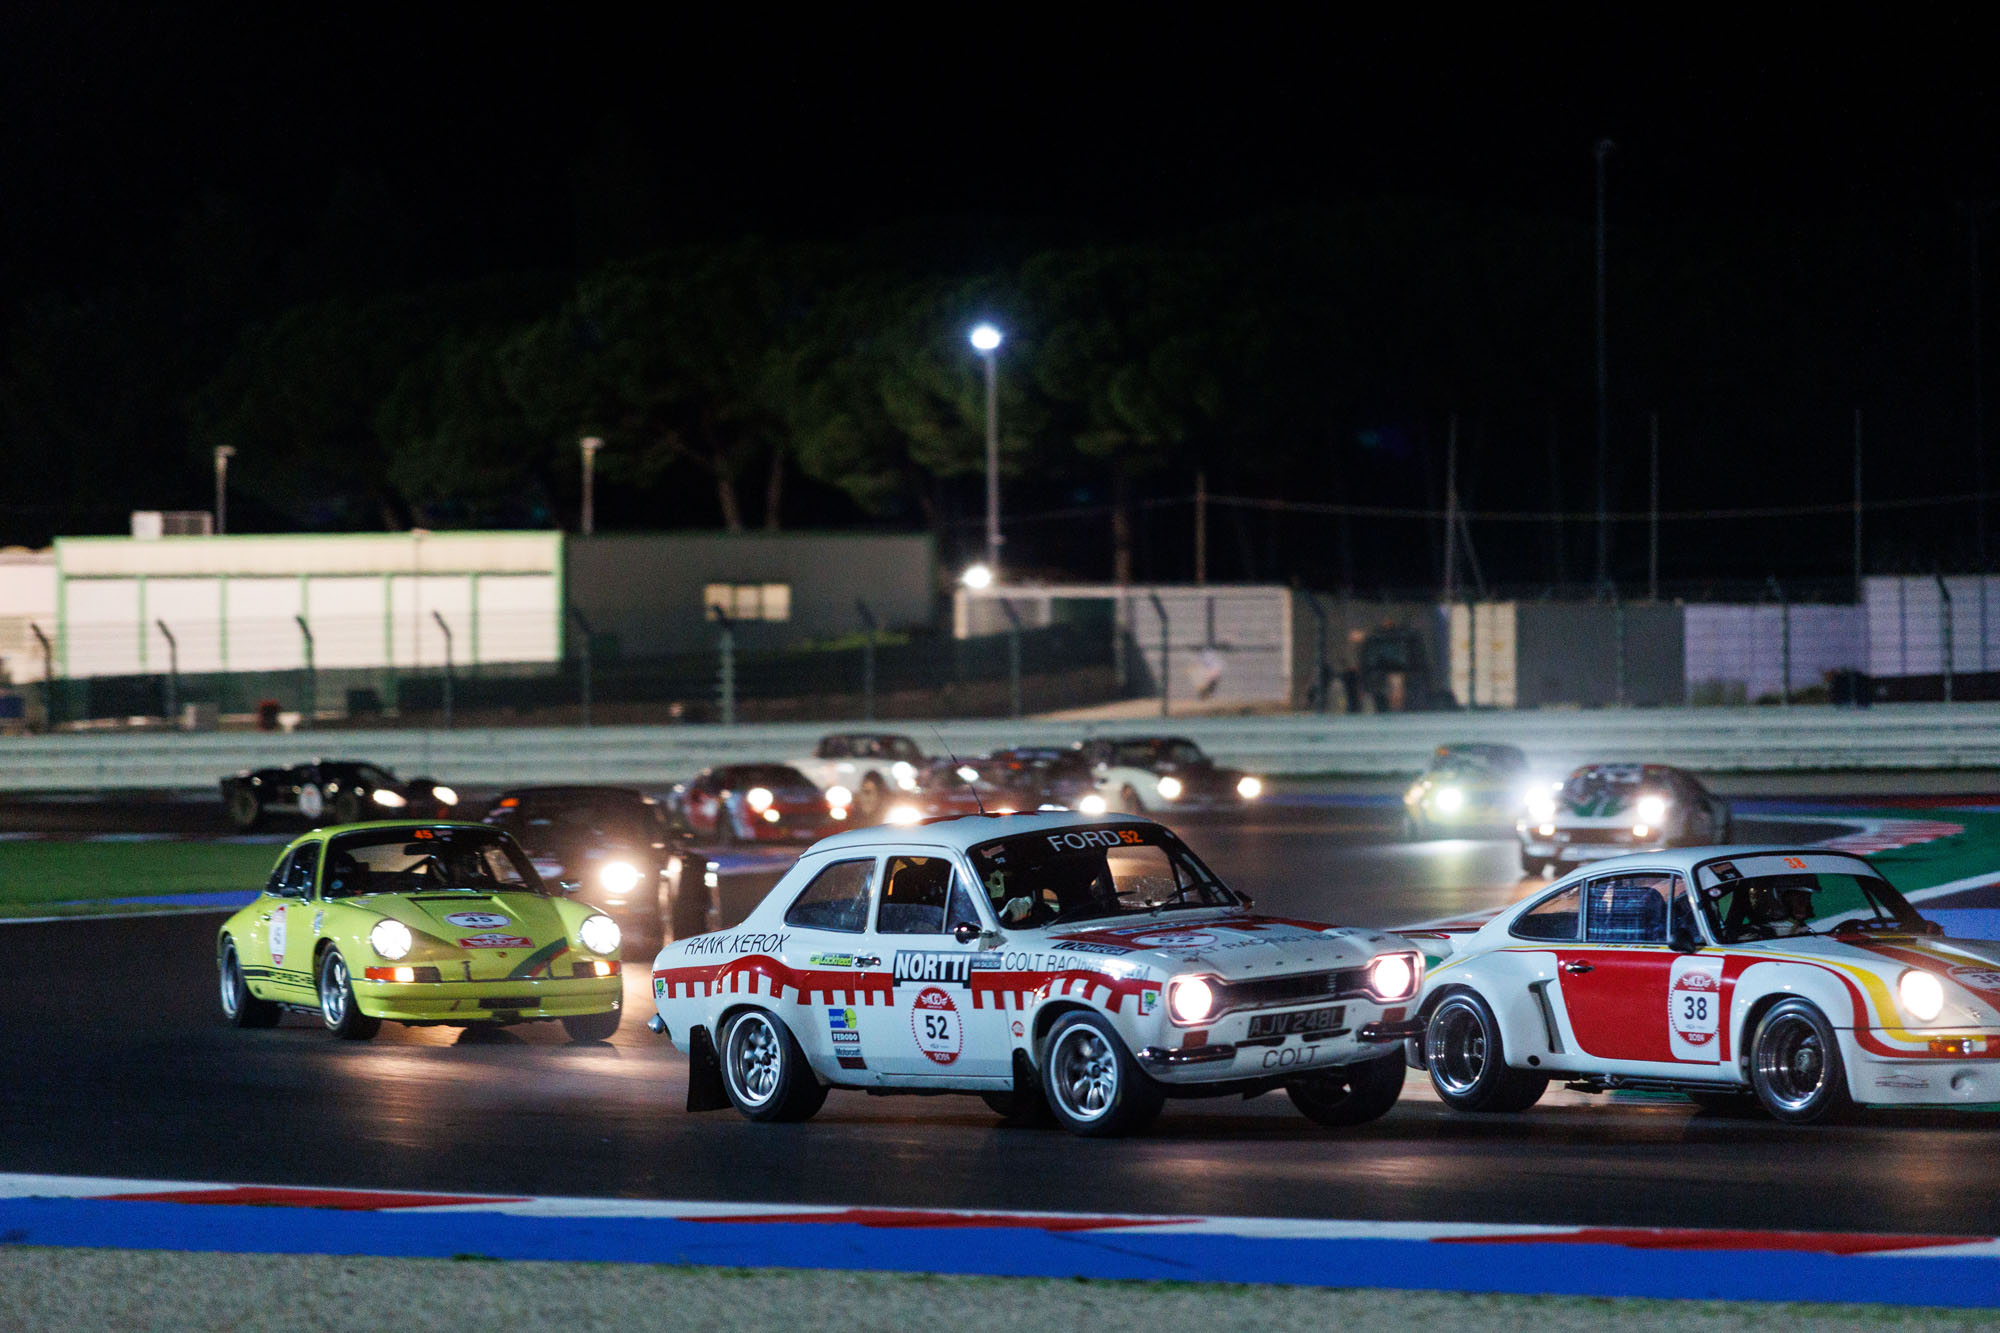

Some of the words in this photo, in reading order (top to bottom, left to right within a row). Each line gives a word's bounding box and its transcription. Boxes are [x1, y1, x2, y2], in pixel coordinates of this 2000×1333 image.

[414, 829, 434, 839] 45
[1046, 830, 1121, 852] FORD
[1118, 830, 1144, 844] 52
[1783, 857, 1807, 869] 38
[684, 935, 732, 955] RANK
[728, 933, 791, 954] XEROX
[895, 953, 971, 981] NORTTI
[1005, 952, 1044, 972] COLT
[1250, 1013, 1291, 1034] AJV
[1292, 1005, 1340, 1030] 248L
[1684, 996, 1707, 1021] 38
[833, 1033, 858, 1041] FERODO
[925, 1014, 950, 1040] 52
[1261, 1045, 1320, 1069] COLT
